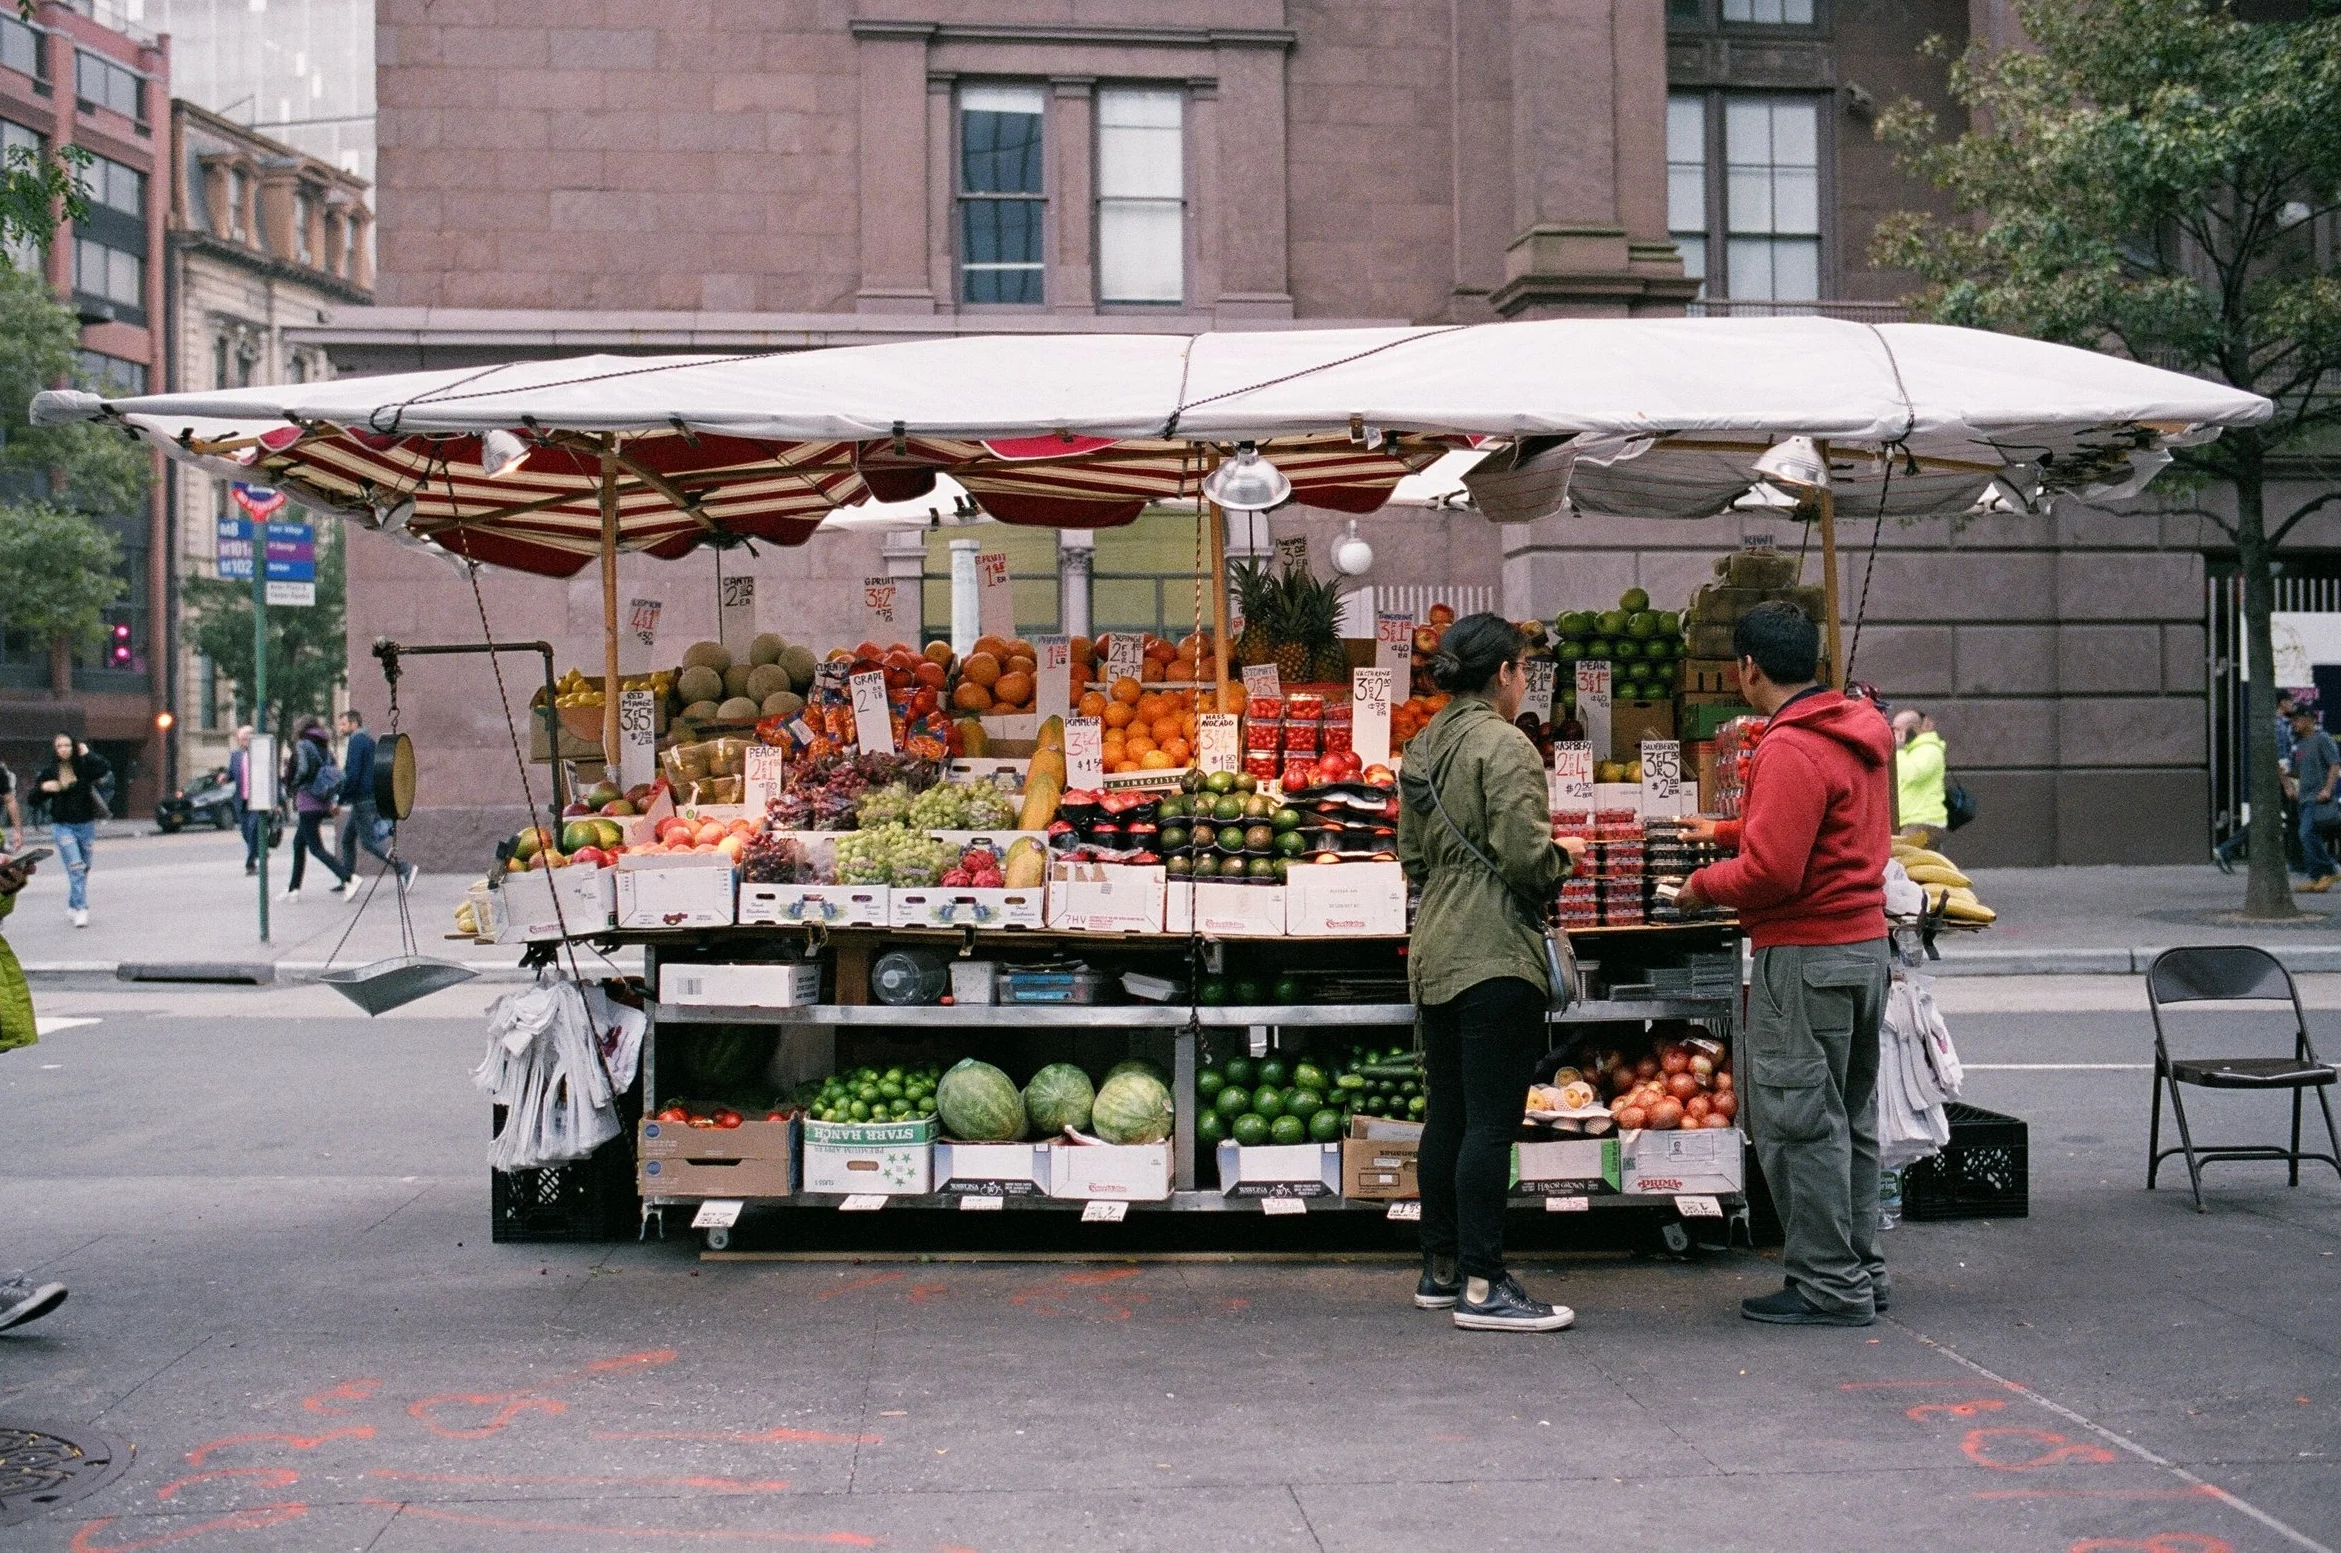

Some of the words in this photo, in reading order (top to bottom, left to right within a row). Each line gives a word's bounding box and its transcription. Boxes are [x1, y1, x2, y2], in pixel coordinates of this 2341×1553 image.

[1744, 534, 1773, 545] KIWI
[221, 560, 253, 574] M102
[865, 588, 877, 607] 3
[1378, 621, 1390, 641] 3
[1109, 643, 1121, 661] 2
[1580, 661, 1607, 670] PEAR
[853, 672, 882, 685] GRAPE
[1578, 672, 1588, 691] 3
[1355, 677, 1368, 701] 3
[621, 708, 633, 730] 3
[1066, 733, 1083, 755] 3
[1201, 730, 1213, 749] 3
[749, 747, 779, 758] PEACH
[750, 759, 761, 780] 2
[1556, 752, 1568, 777] 2
[1644, 752, 1657, 778] 3
[1065, 915, 1086, 924] 7HV
[813, 1128, 861, 1140] RANCH
[866, 1128, 914, 1140] STARR
[1640, 1179, 1680, 1190] PRIMA
